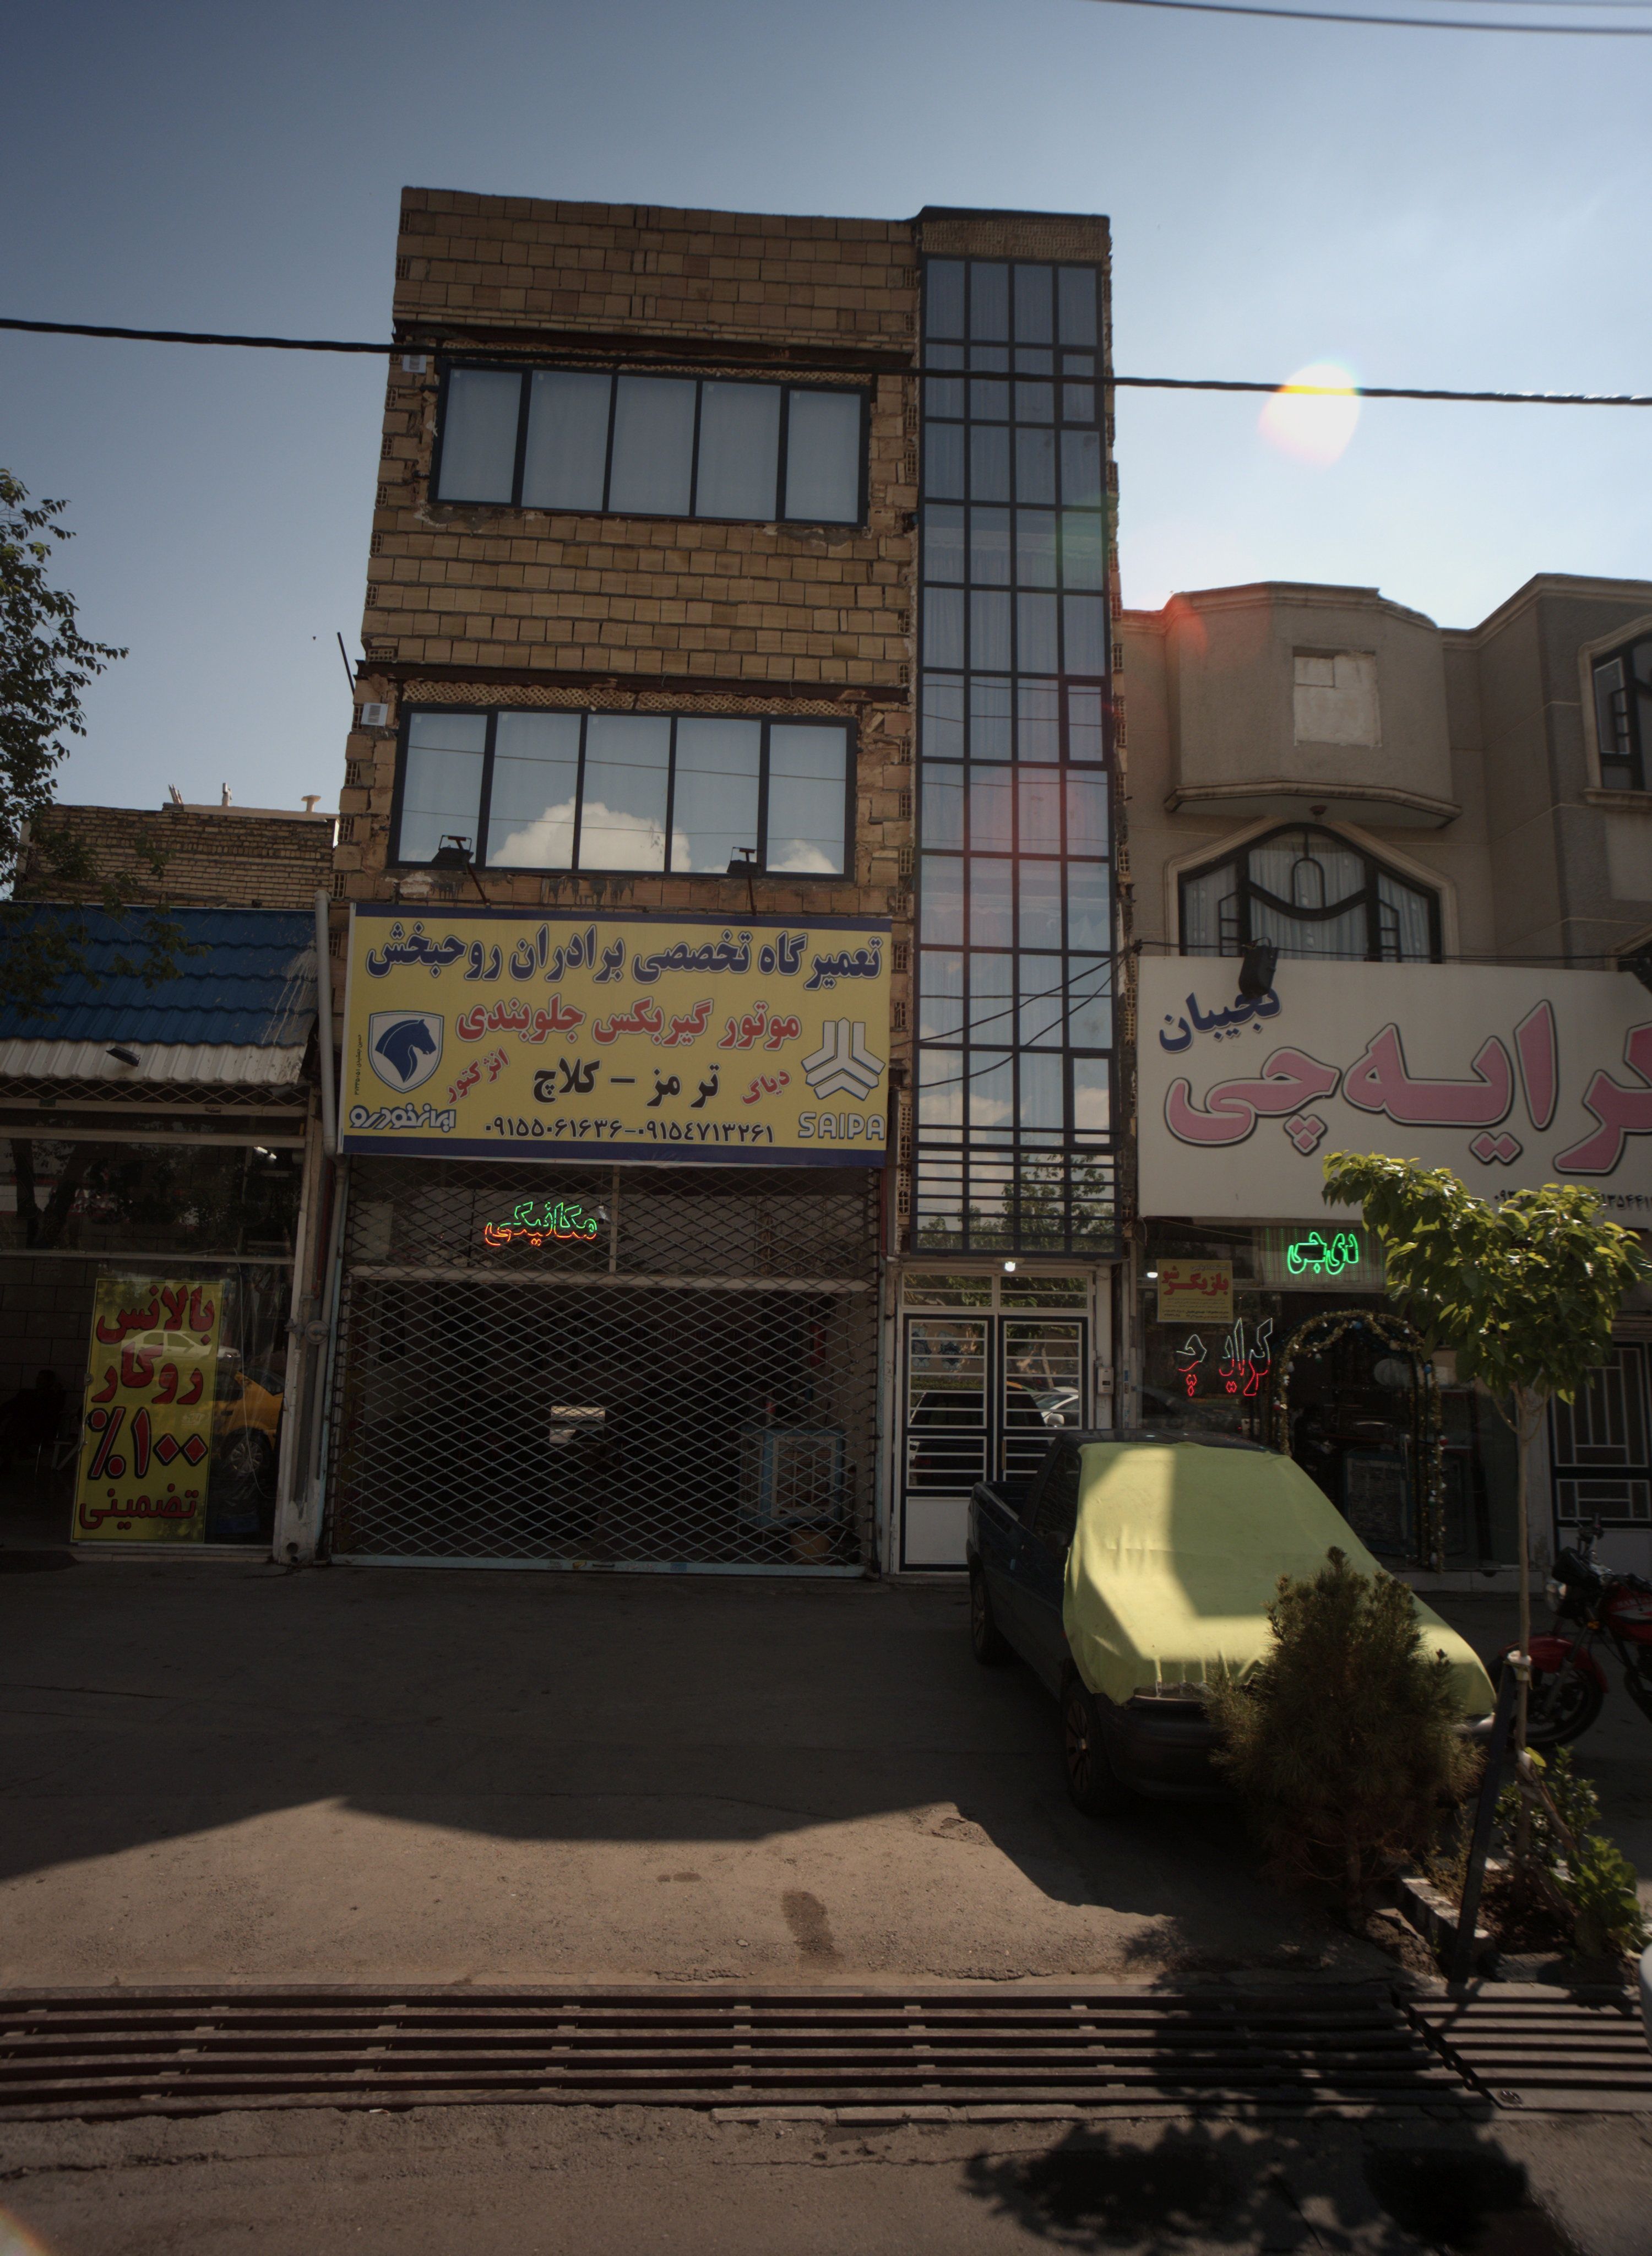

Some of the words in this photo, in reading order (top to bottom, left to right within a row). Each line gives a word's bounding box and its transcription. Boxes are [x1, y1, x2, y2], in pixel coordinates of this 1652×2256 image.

[367, 923, 501, 980] روحبخش
[509, 925, 625, 982] برادران
[633, 931, 751, 983] تخصصی
[457, 994, 584, 1043] جلوبندی
[594, 998, 711, 1046] گیربکس
[719, 1002, 800, 1048] موتور
[534, 1058, 599, 1102] کلاچ
[742, 1069, 791, 1106] دیاگ
[799, 1113, 884, 1141] SAIPA
[485, 1201, 598, 1247] مکانیکی
[1164, 1272, 1229, 1295] بازیگر
[96, 1284, 215, 1344] بالانس
[79, 1483, 199, 1530] تضمینی
